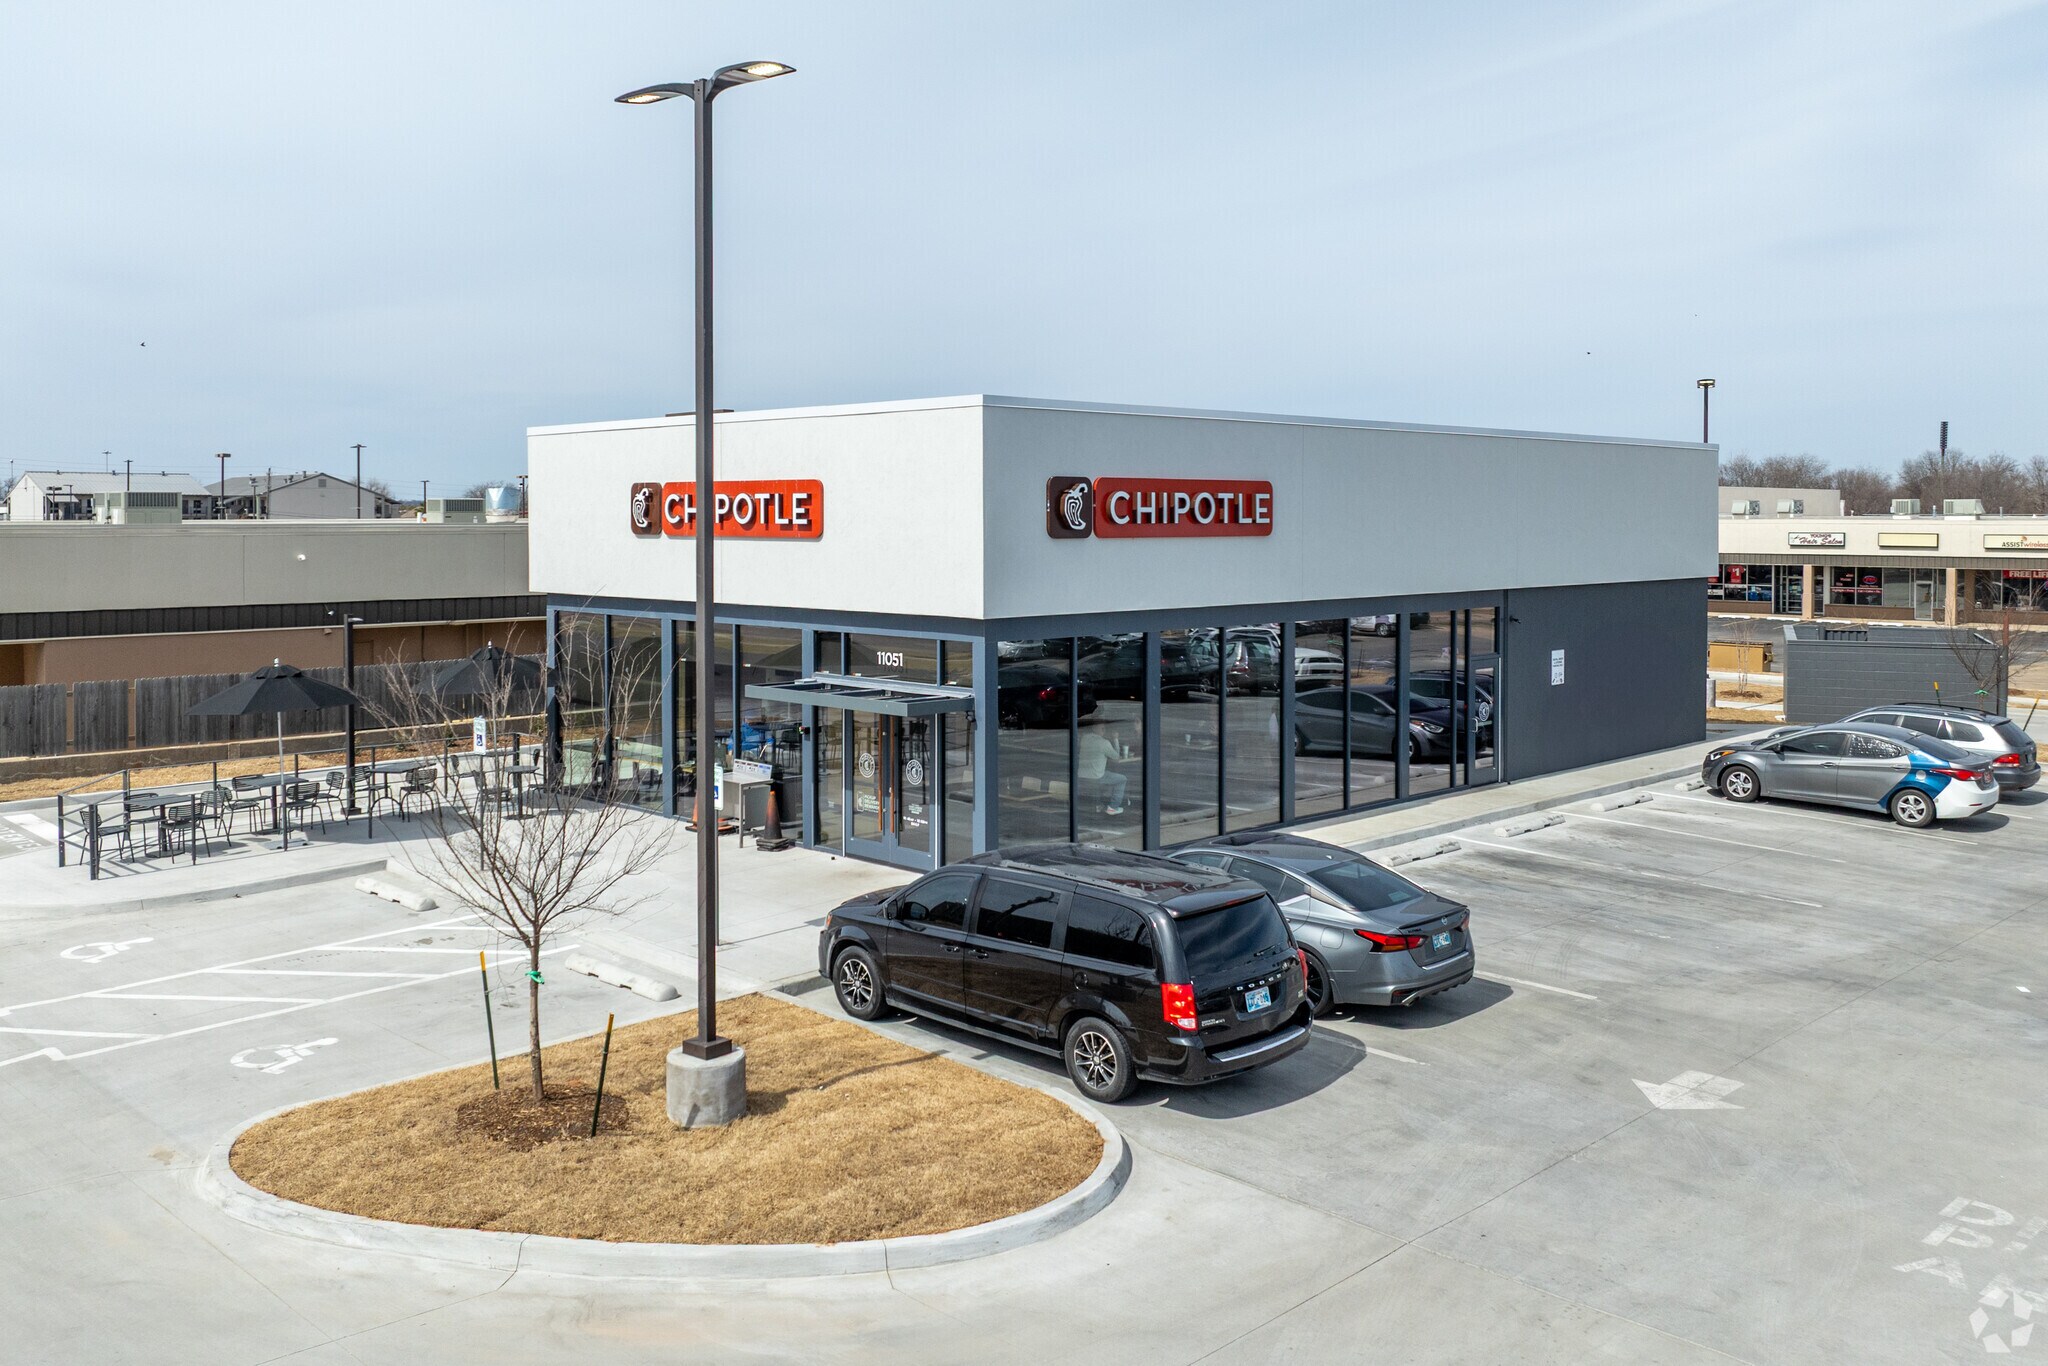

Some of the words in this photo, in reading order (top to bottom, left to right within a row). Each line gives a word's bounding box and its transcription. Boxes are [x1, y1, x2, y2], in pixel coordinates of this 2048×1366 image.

[664, 492, 808, 525] CHPOTLE
[1109, 490, 1270, 525] CHIPOTLE
[2009, 570, 2031, 578] FREE
[876, 651, 903, 667] 11051
[1236, 973, 1282, 991] DODGE
